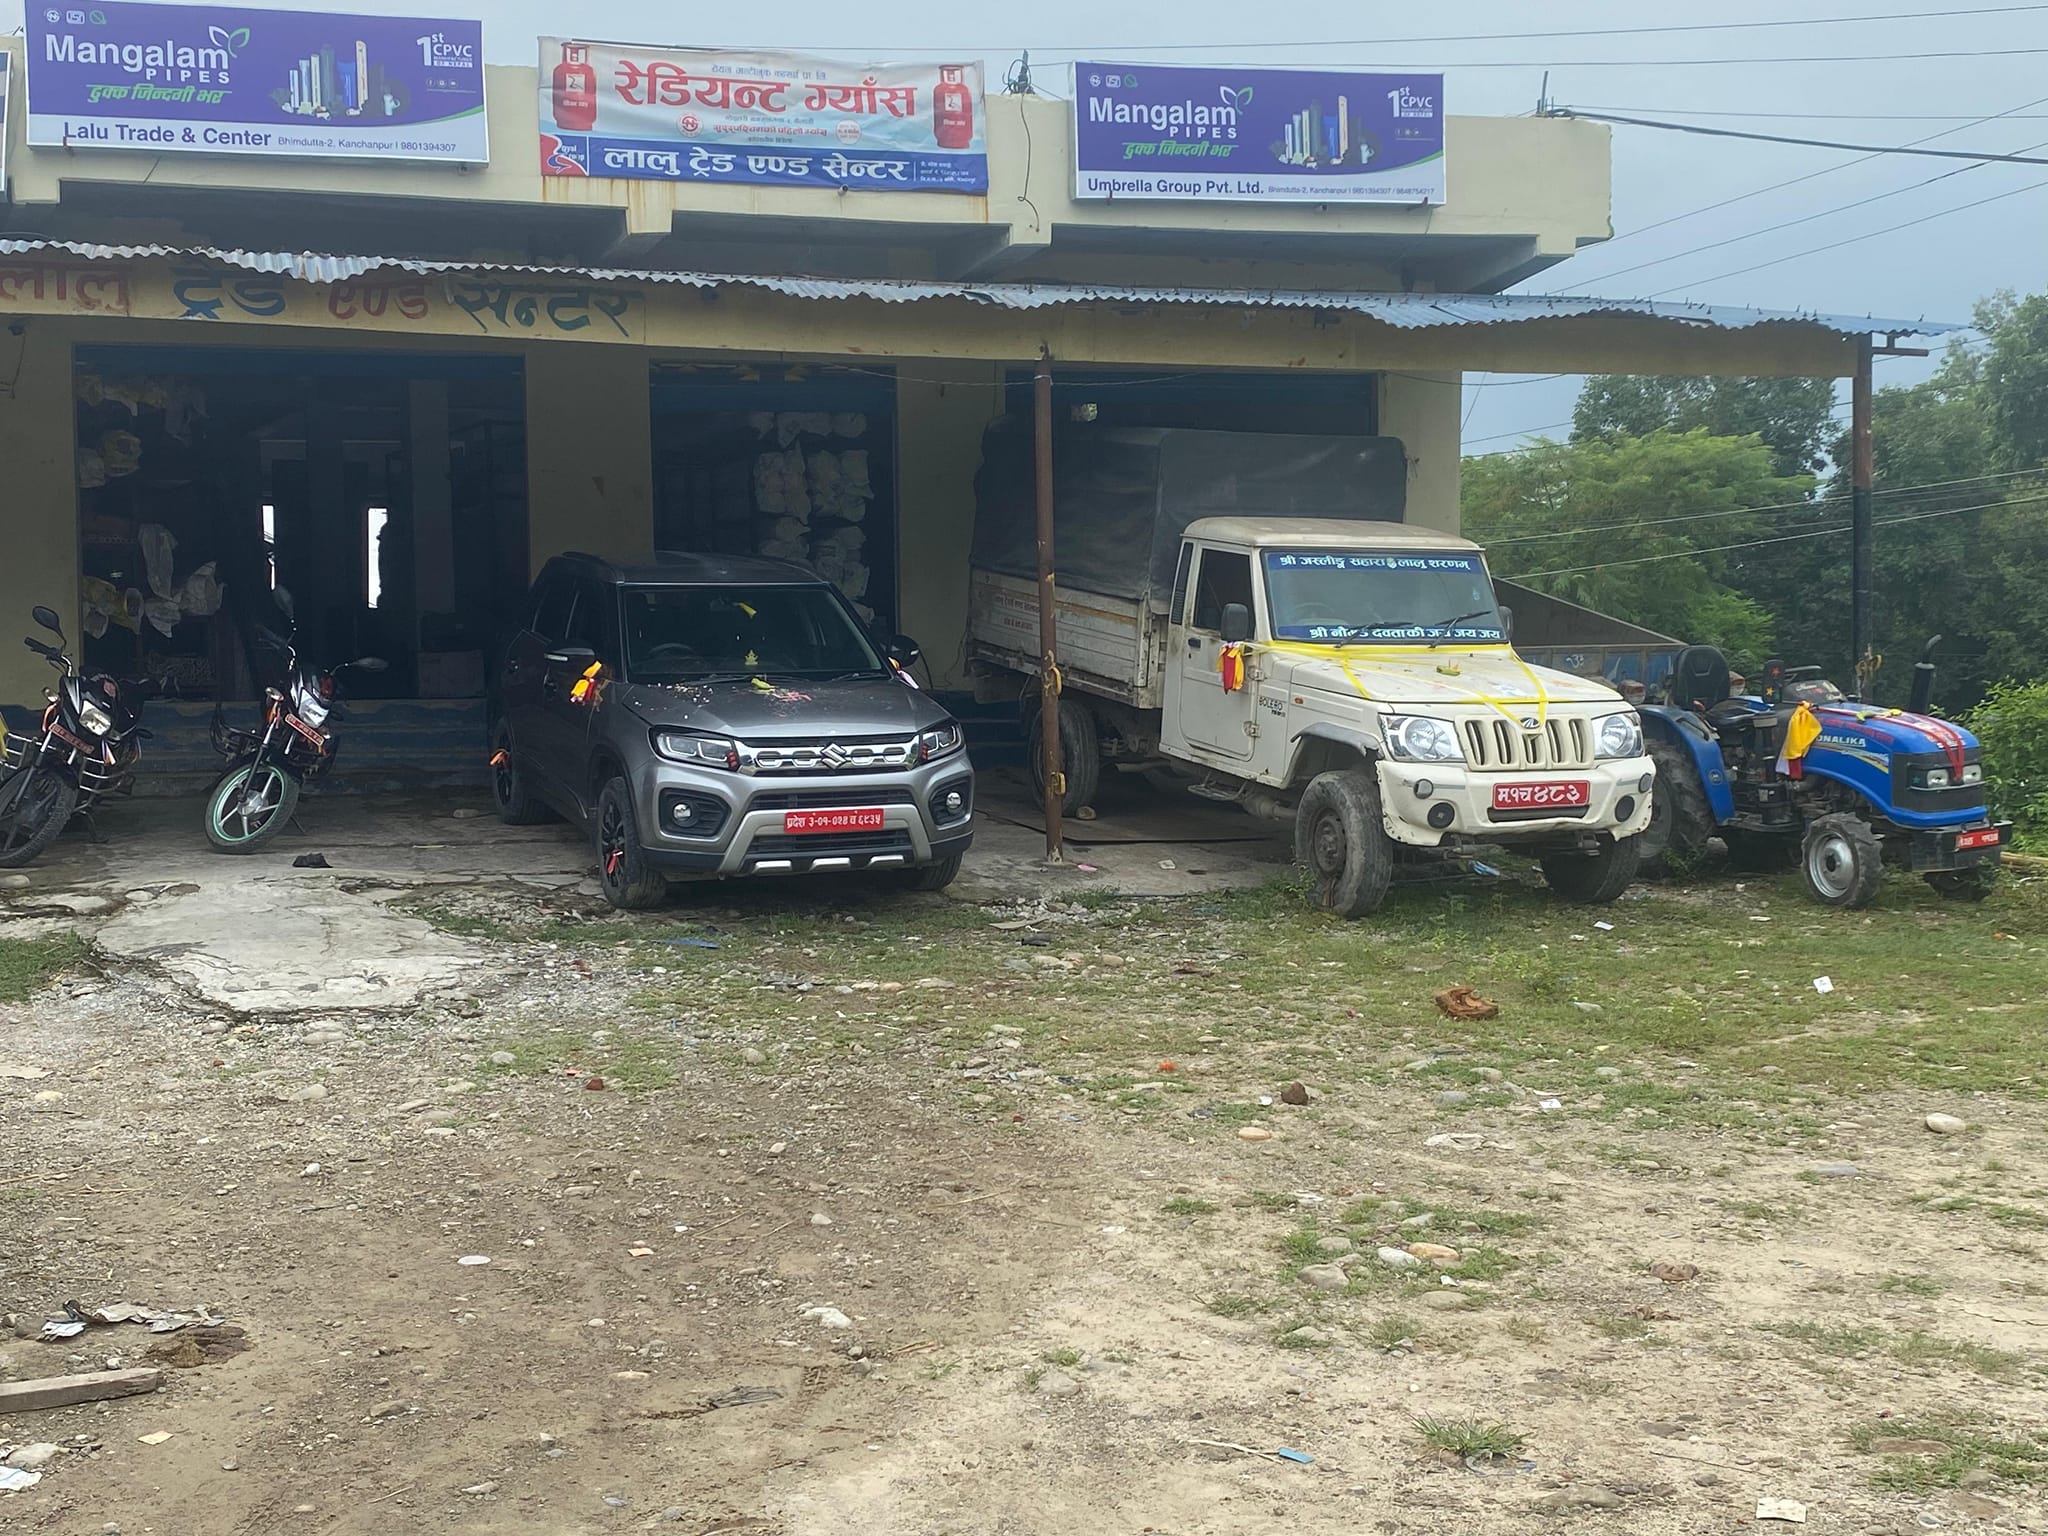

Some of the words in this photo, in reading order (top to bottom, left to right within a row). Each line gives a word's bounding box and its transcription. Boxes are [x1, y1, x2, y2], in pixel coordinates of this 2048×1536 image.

[45, 34, 229, 73] Mangalam
[433, 43, 473, 57] CPVC
[145, 68, 230, 84] PIPES
[614, 60, 791, 112] रेडियन्ट
[804, 75, 918, 118] ग्याँस
[1401, 96, 1433, 107] CPVC
[1089, 97, 1236, 131] Mangalam
[64, 122, 109, 140] Lalu
[115, 124, 175, 142] Trade
[181, 127, 196, 143] &
[203, 127, 272, 146] Center
[1169, 126, 1237, 139] PIPES
[338, 138, 393, 151] Kanchanpur
[401, 142, 456, 152] 9801394307
[603, 148, 680, 175] लालु
[688, 146, 737, 177] ट्रेड
[746, 155, 813, 175] एण्ड
[821, 153, 911, 181] सेन्टर
[1088, 178, 1152, 192] Umbrella
[1156, 179, 1202, 196] Group
[1206, 180, 1233, 194] Pvt.
[1237, 180, 1264, 194] Ltd.
[1279, 555, 1296, 566] श्री
[1349, 557, 1385, 567] सहारा
[1397, 558, 1427, 569] लालु
[1309, 626, 1328, 638] श्री
[1454, 628, 1476, 638] जय
[1477, 629, 1500, 639] जय
[1815, 734, 1867, 748] ONALIKA
[787, 814, 806, 829] प्रदेश
